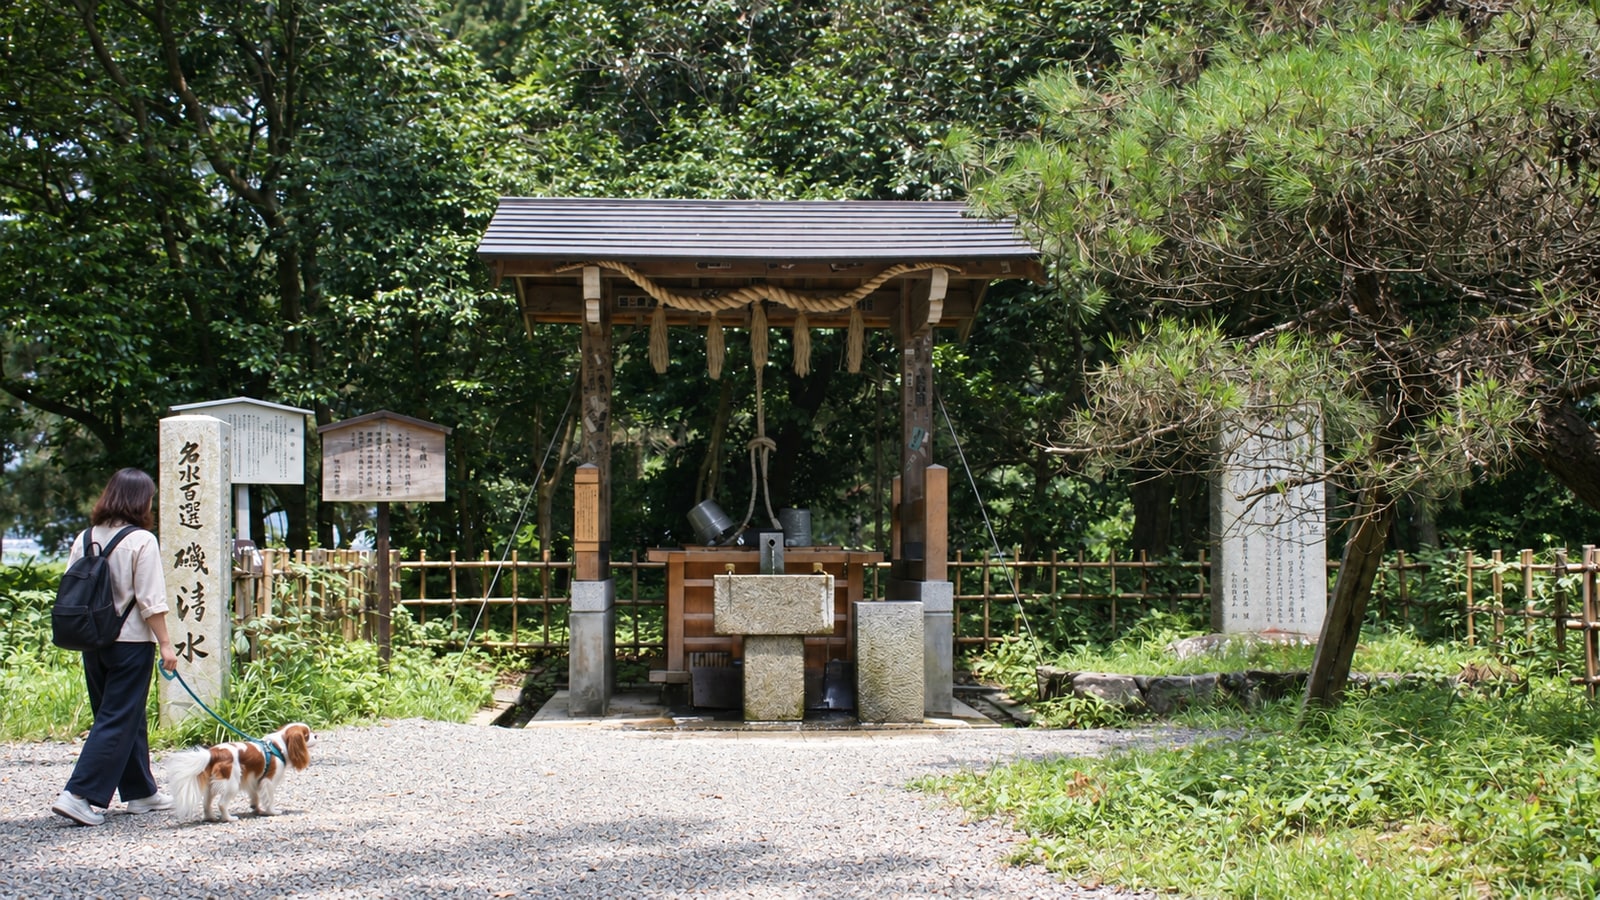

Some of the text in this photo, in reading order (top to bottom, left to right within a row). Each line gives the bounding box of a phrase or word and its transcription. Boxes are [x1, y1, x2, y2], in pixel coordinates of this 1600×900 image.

[174, 441, 209, 664] 名水百選 磯清水
